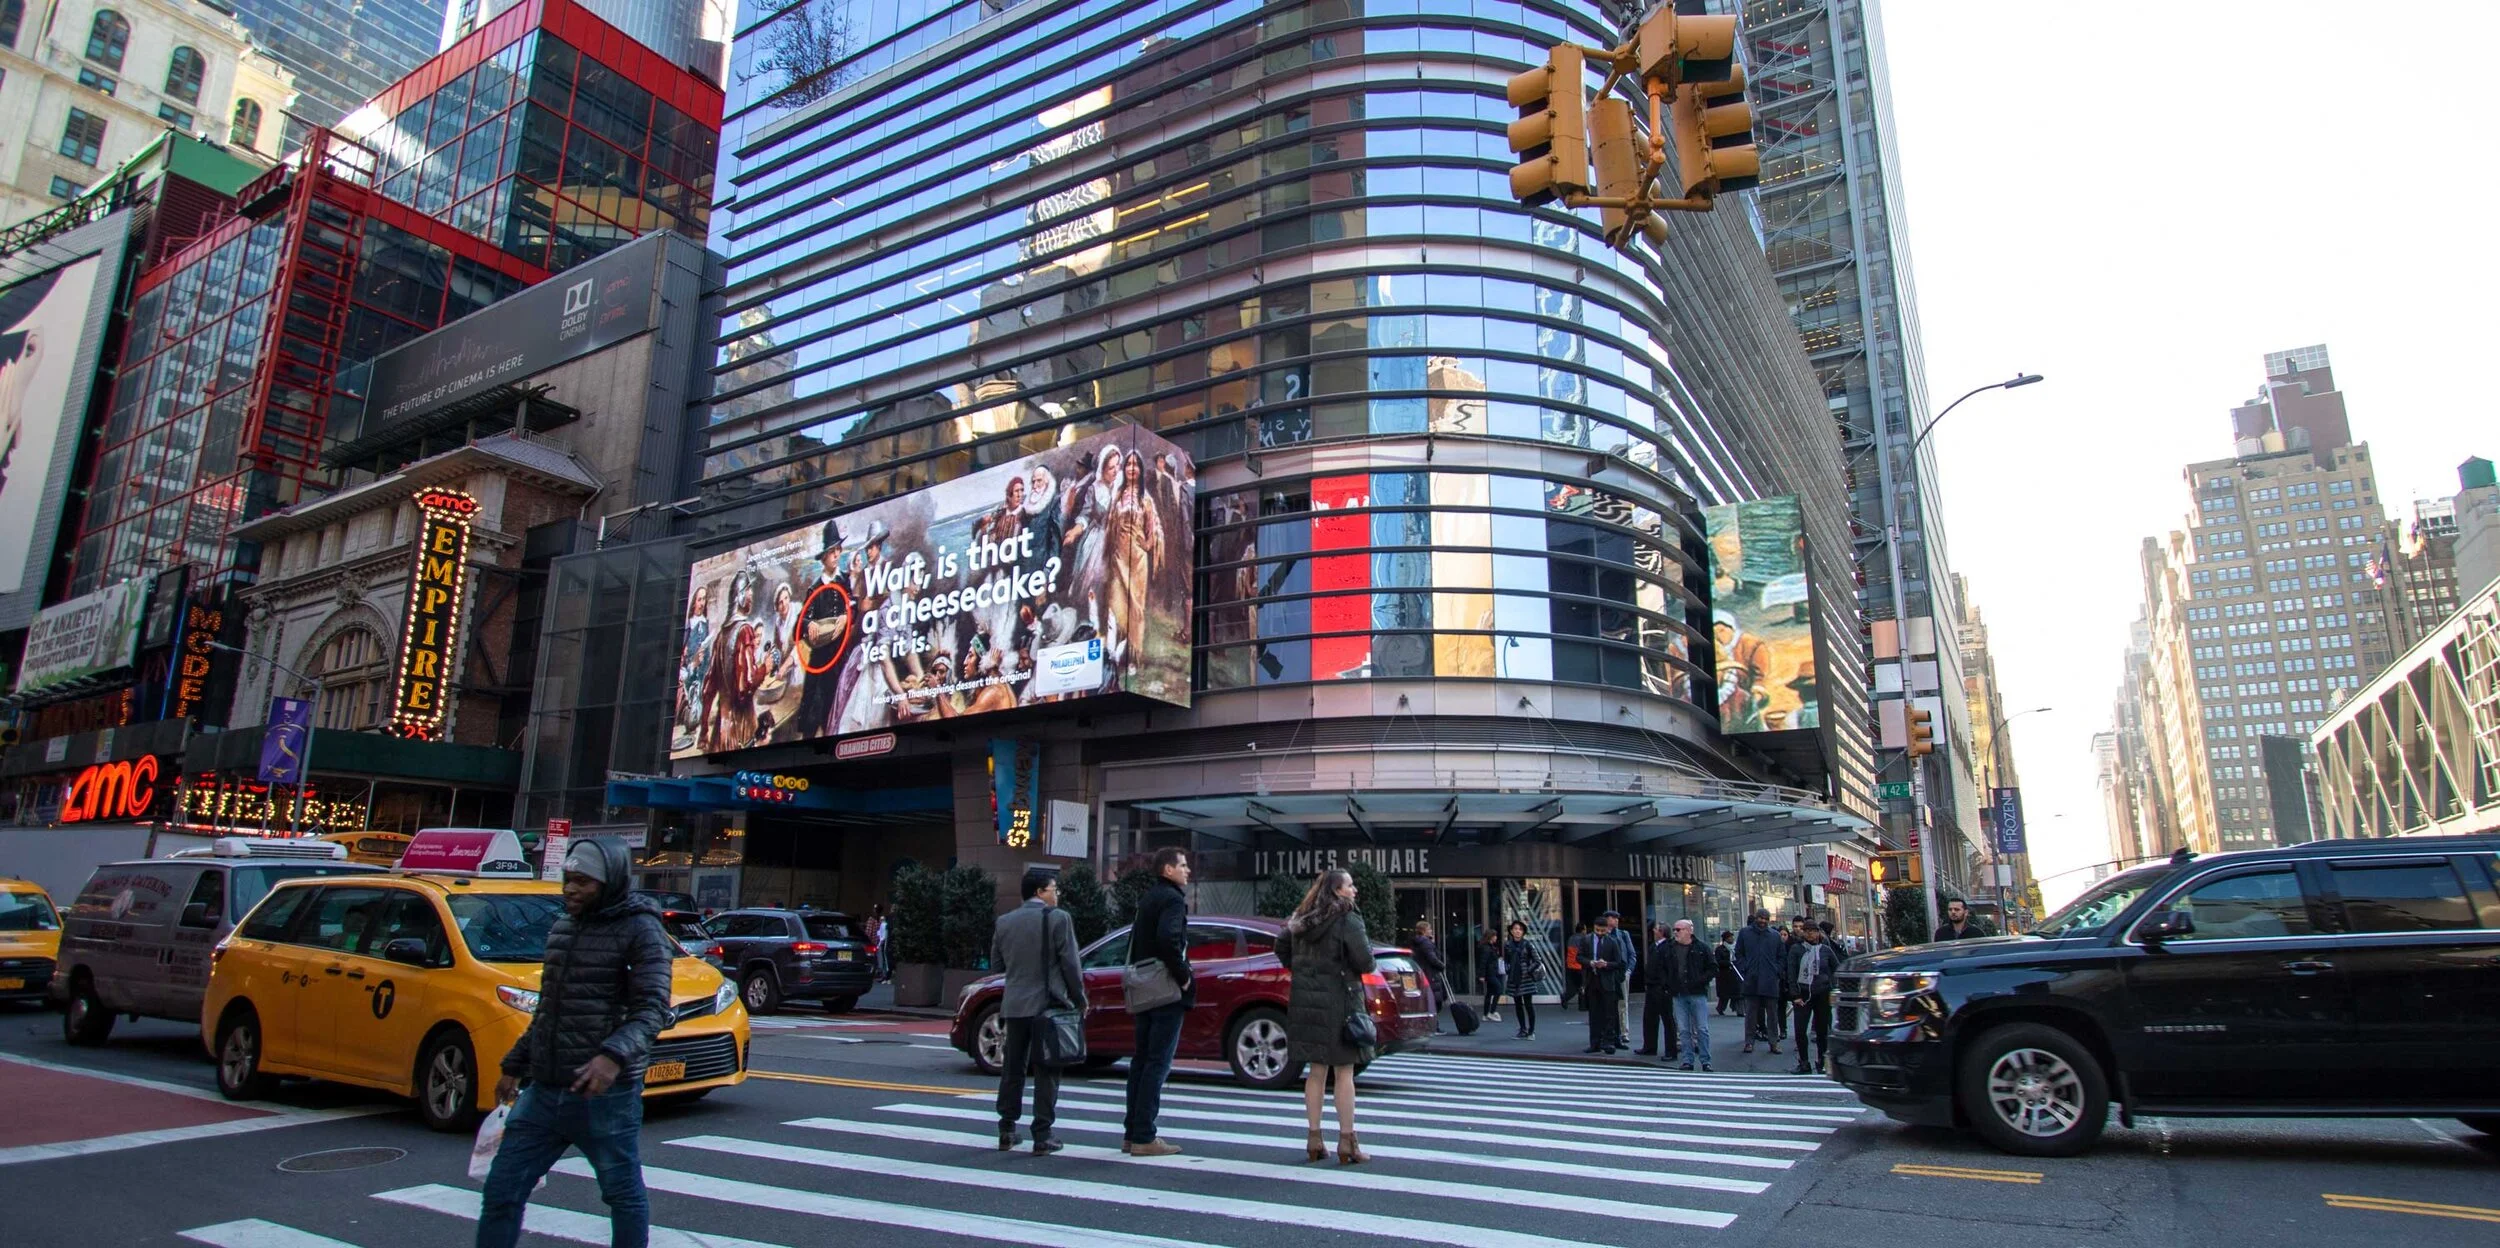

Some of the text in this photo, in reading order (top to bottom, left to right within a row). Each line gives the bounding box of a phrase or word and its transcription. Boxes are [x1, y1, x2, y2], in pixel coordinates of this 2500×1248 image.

[560, 323, 586, 341] CINEMA
[561, 310, 588, 329] DOLBY
[383, 354, 524, 420] THE FUTURE OF CINEMA IS HERE
[786, 539, 803, 550] Ferris
[864, 527, 1034, 598] Wait, is that
[862, 556, 1062, 634] a cheesecake?
[31, 602, 103, 643] GOT ANXIETY?
[408, 525, 457, 710] EMPIRE
[28, 644, 41, 659] TRY
[42, 637, 56, 653] THE
[83, 623, 98, 640] CBD
[860, 630, 931, 663] Yes it is.
[1050, 655, 1085, 670] PHILADELPHIA
[872, 669, 1032, 705] Make your Thanksgiving dessert the original
[839, 736, 892, 756] BRANDED CITIES
[1880, 785, 1888, 797] W
[1890, 784, 1901, 796] 42
[2001, 797, 2019, 842] FROZEN
[495, 861, 518, 870] 3F94
[1255, 851, 1268, 875] 11
[1276, 850, 1337, 874] TIMES
[1628, 854, 1641, 877] 11
[1645, 855, 1682, 879] TIMES
